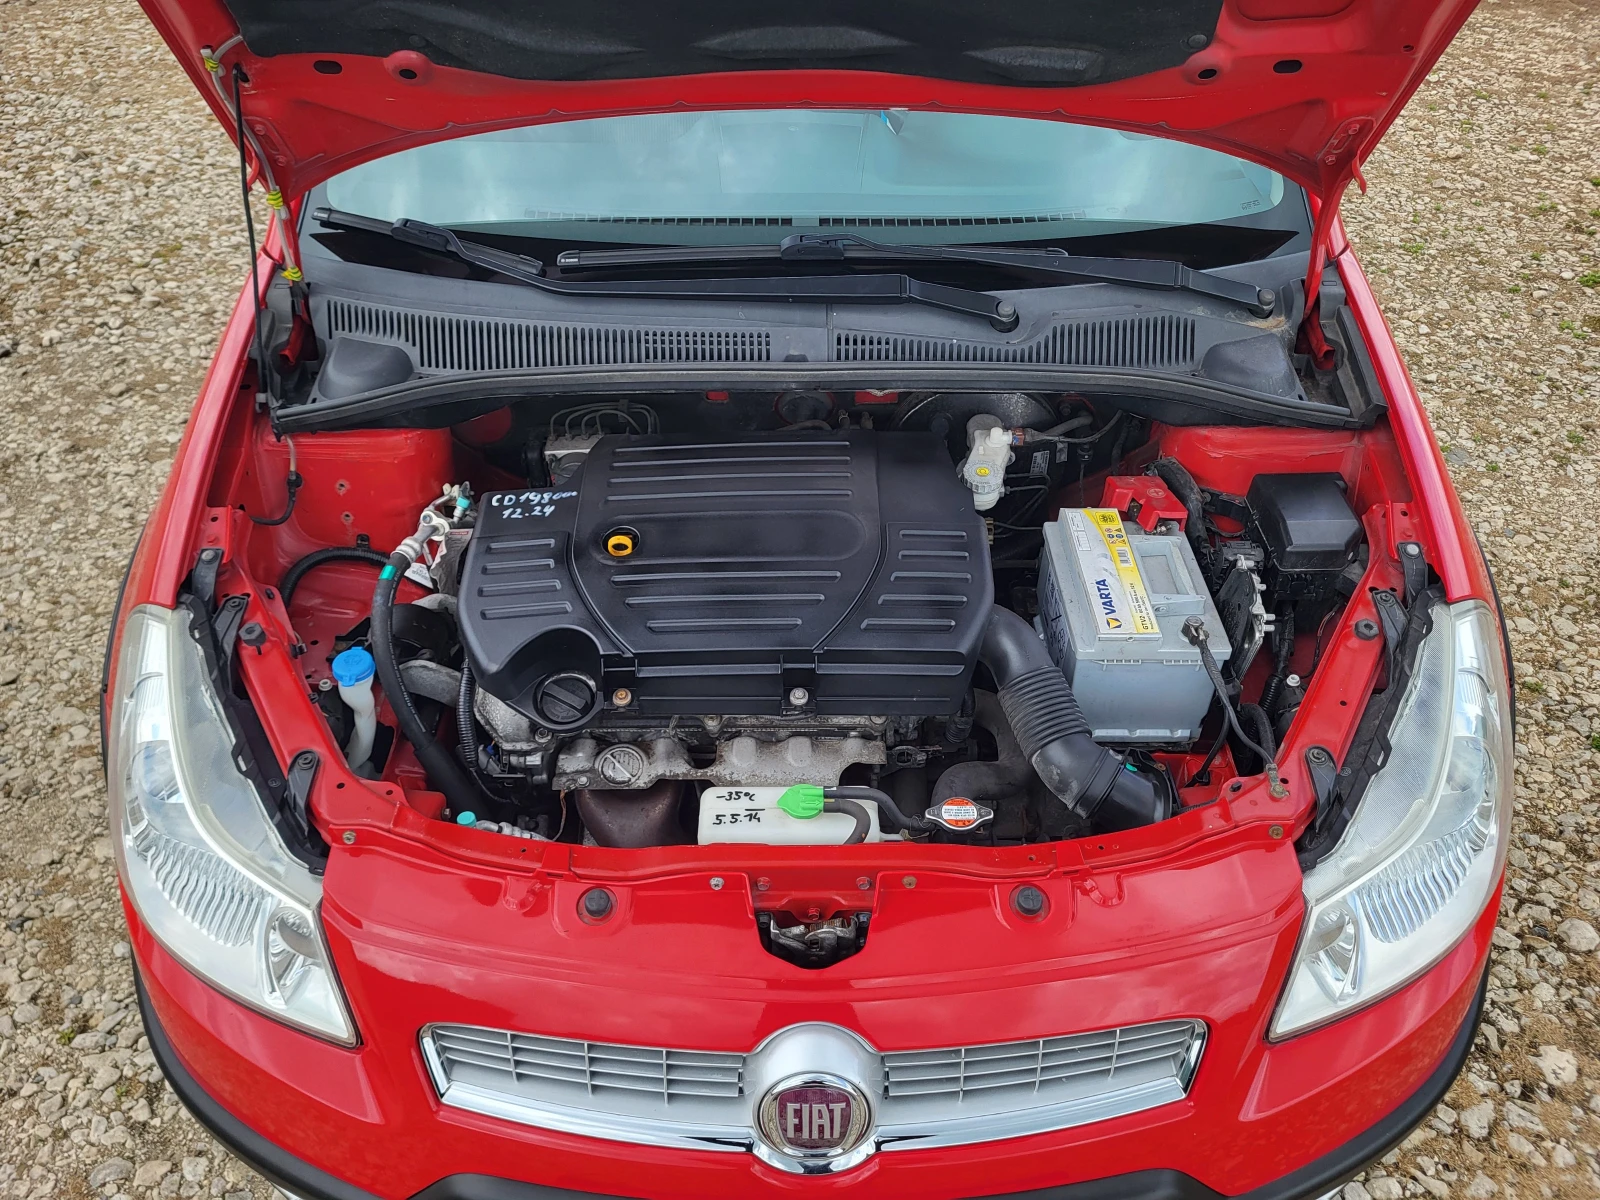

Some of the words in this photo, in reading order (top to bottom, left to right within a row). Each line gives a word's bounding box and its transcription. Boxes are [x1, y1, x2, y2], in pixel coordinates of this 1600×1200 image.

[502, 505, 555, 519] 12.24
[1095, 579, 1117, 615] VARTA
[786, 1102, 847, 1139] FIAT
